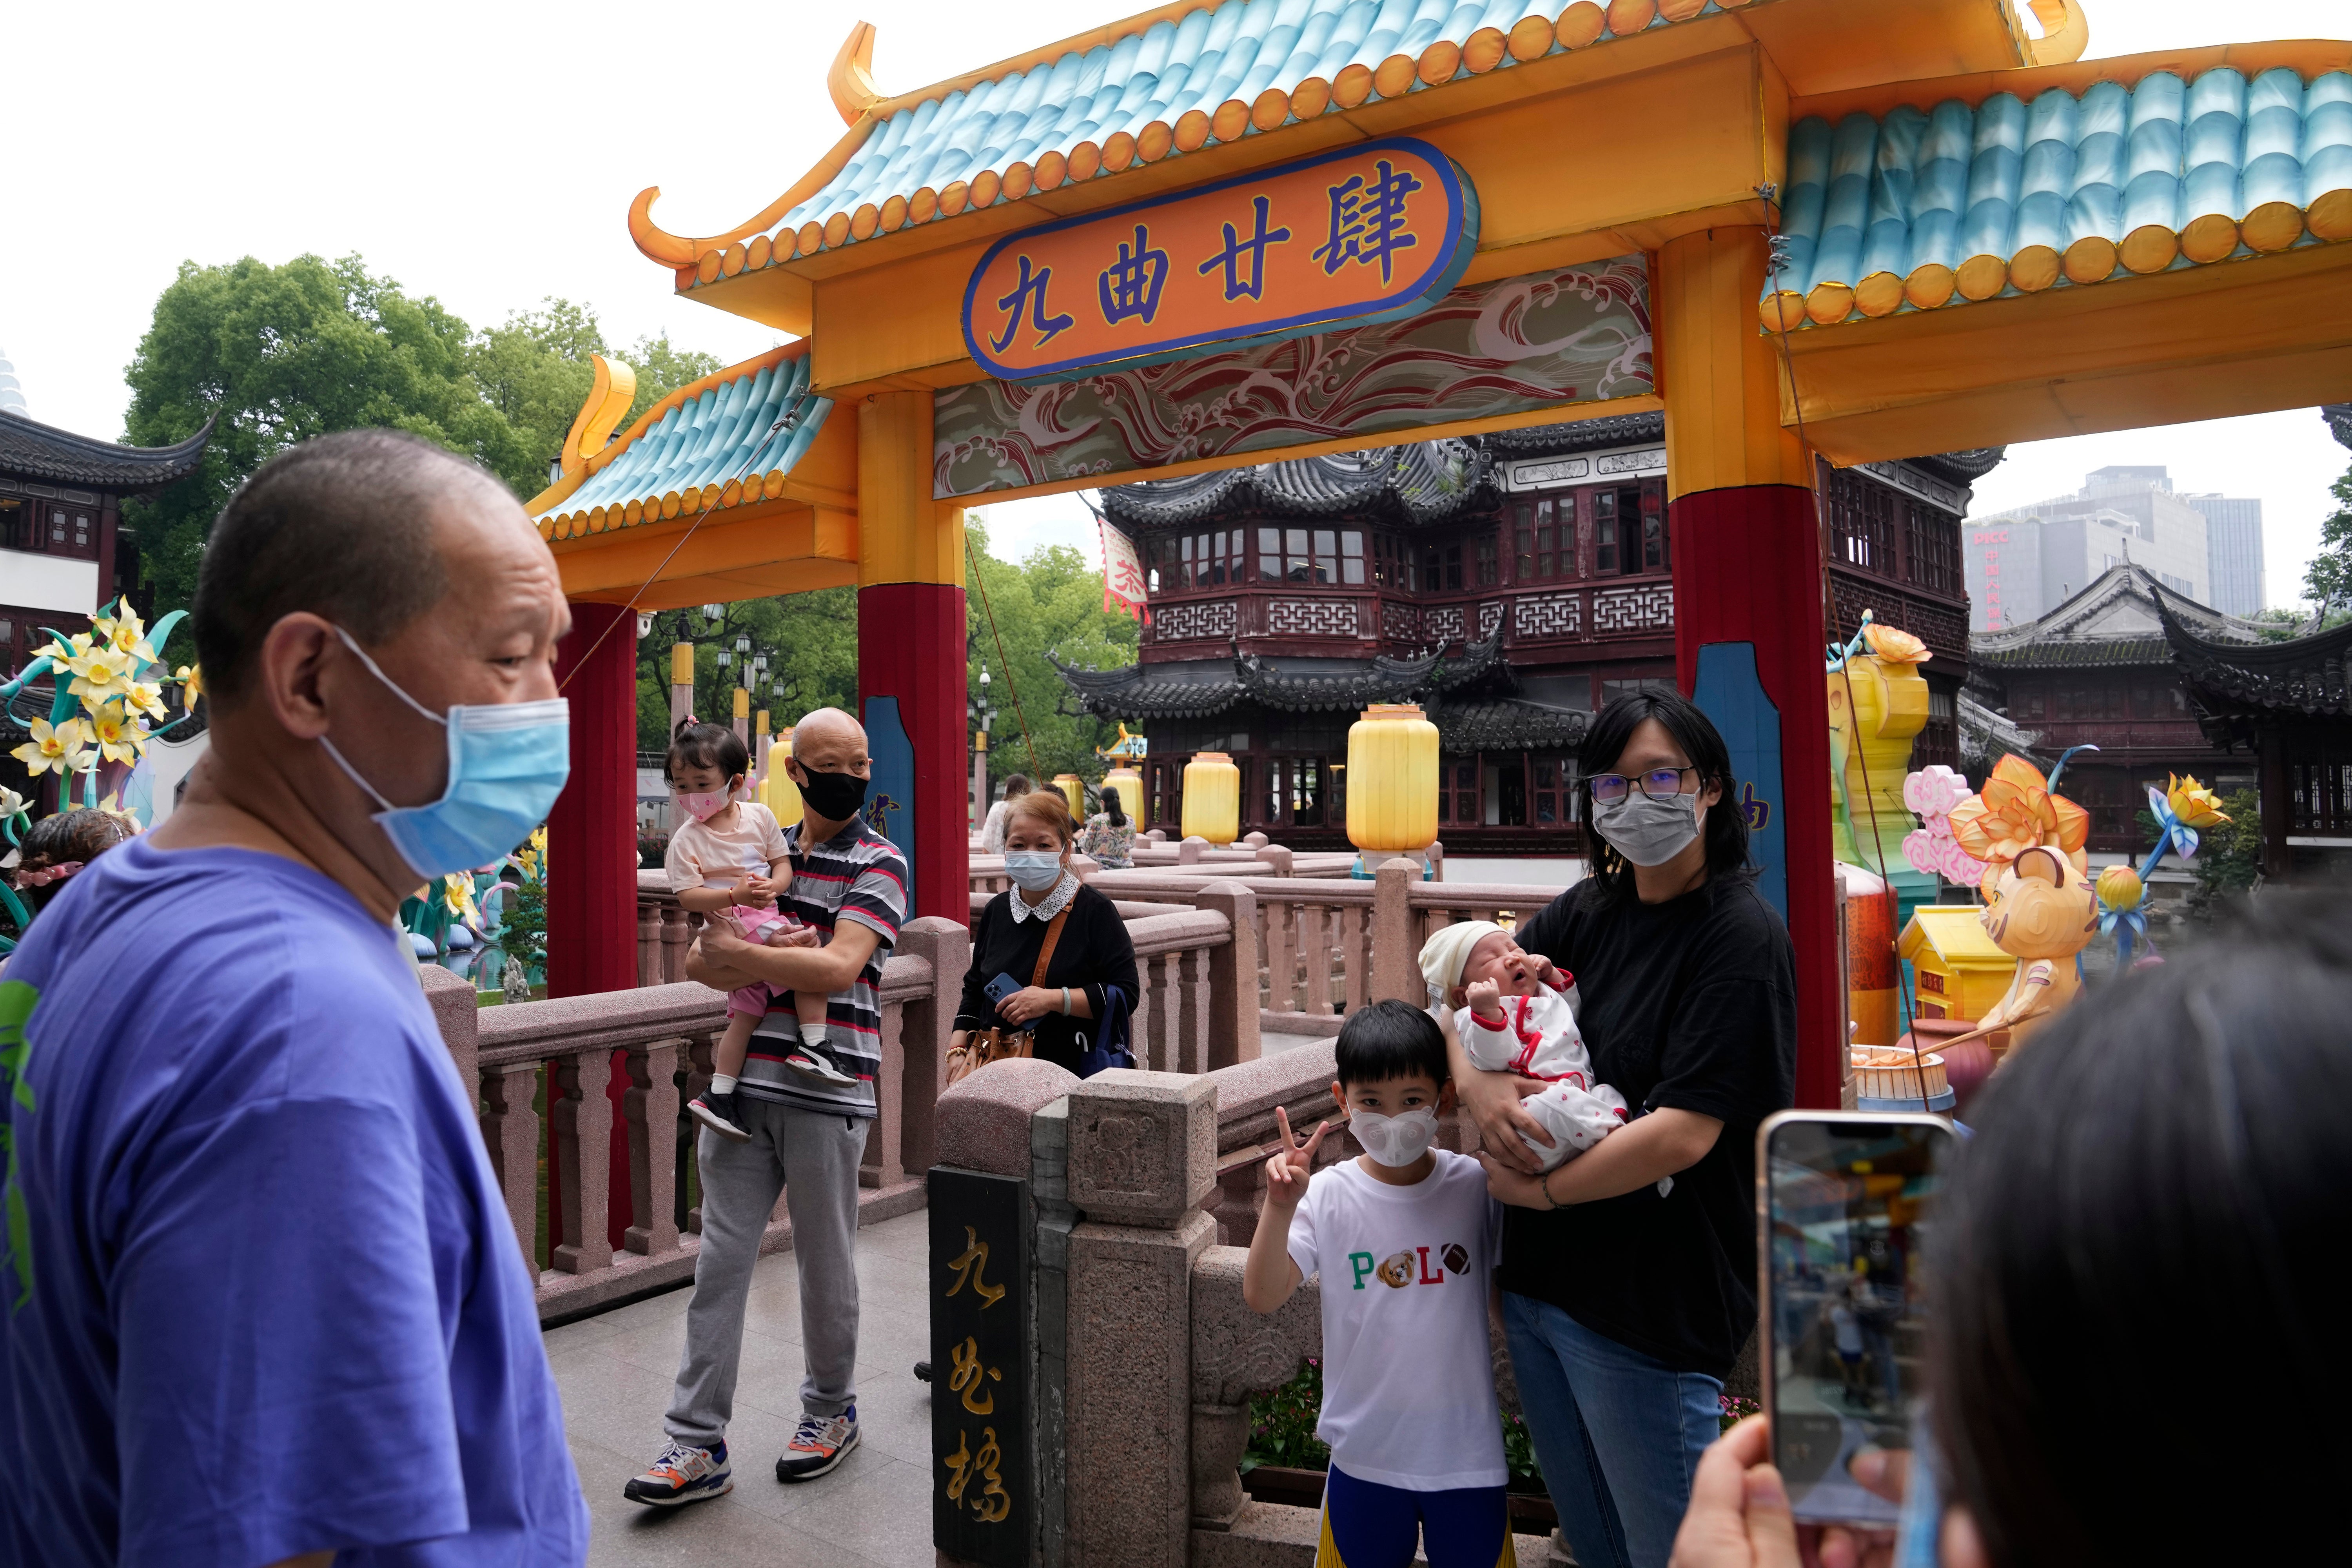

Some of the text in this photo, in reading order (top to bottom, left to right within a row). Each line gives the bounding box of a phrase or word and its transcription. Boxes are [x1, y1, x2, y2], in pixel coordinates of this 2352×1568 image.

[988, 158, 1423, 354] 九曲廿肆
[1974, 531, 2008, 544] PICC
[1115, 560, 1144, 595] 茶
[1985, 550, 2001, 631] 中国人民保险
[828, 1425, 846, 1445] N
[684, 1456, 706, 1479] N
